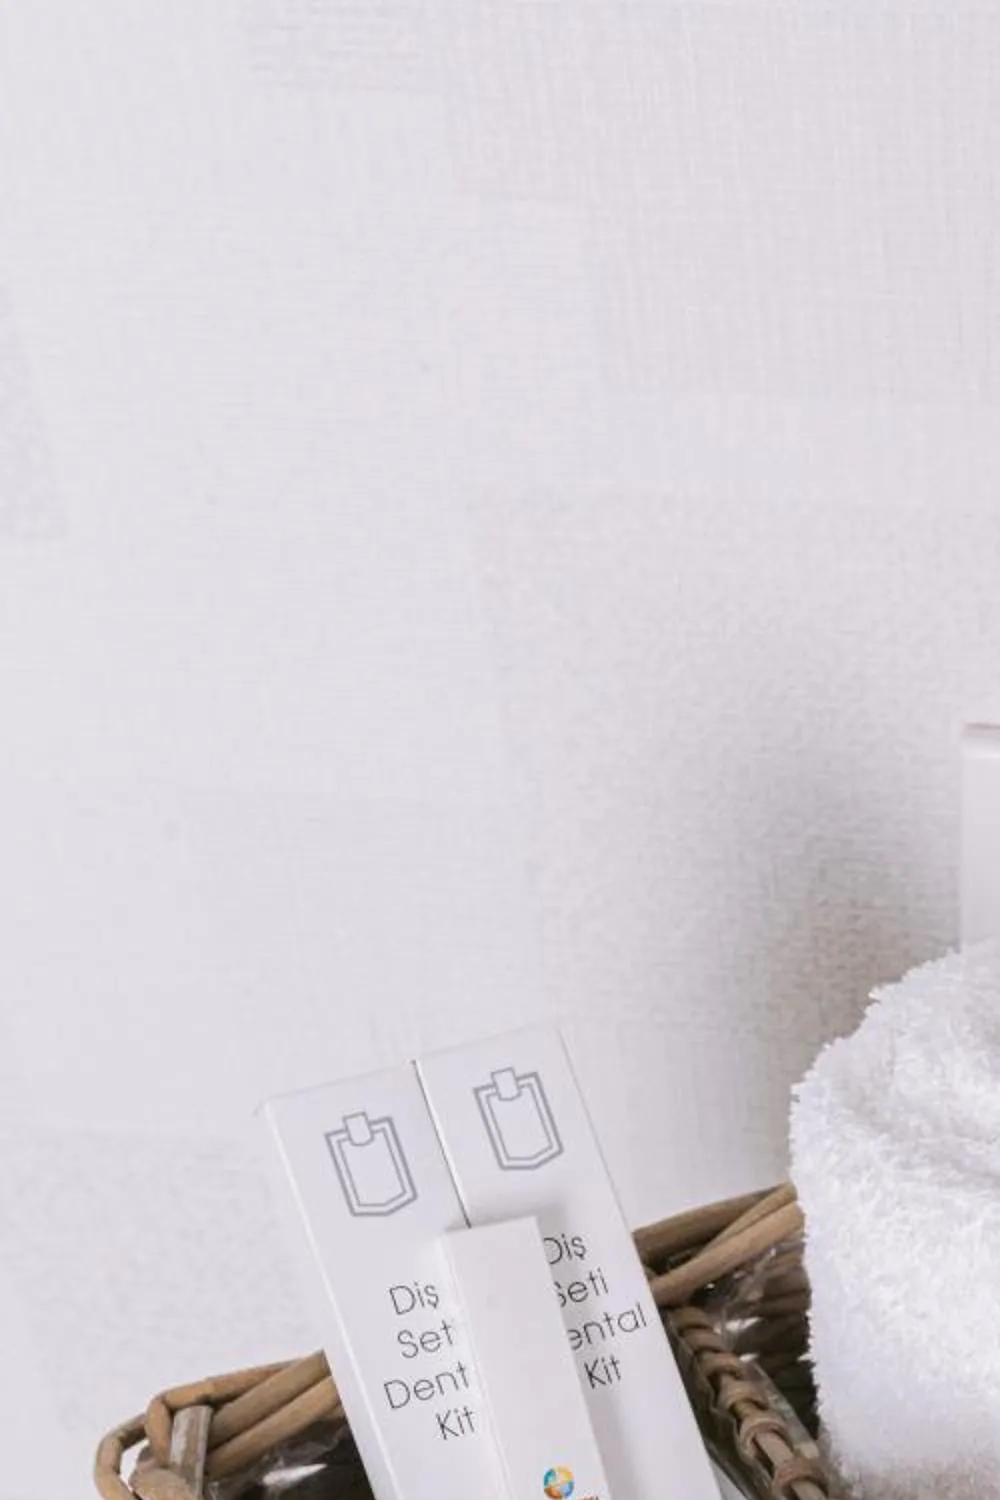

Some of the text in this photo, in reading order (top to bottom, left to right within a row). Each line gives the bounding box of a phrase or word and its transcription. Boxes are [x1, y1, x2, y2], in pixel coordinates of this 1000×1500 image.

[544, 1233, 587, 1265] Diş
[389, 1281, 440, 1316] Diş
[397, 1319, 454, 1359] Set
[567, 1302, 648, 1350] ental
[384, 1360, 470, 1409] Dent
[583, 1354, 622, 1390] Kit
[435, 1405, 475, 1441] Kit
